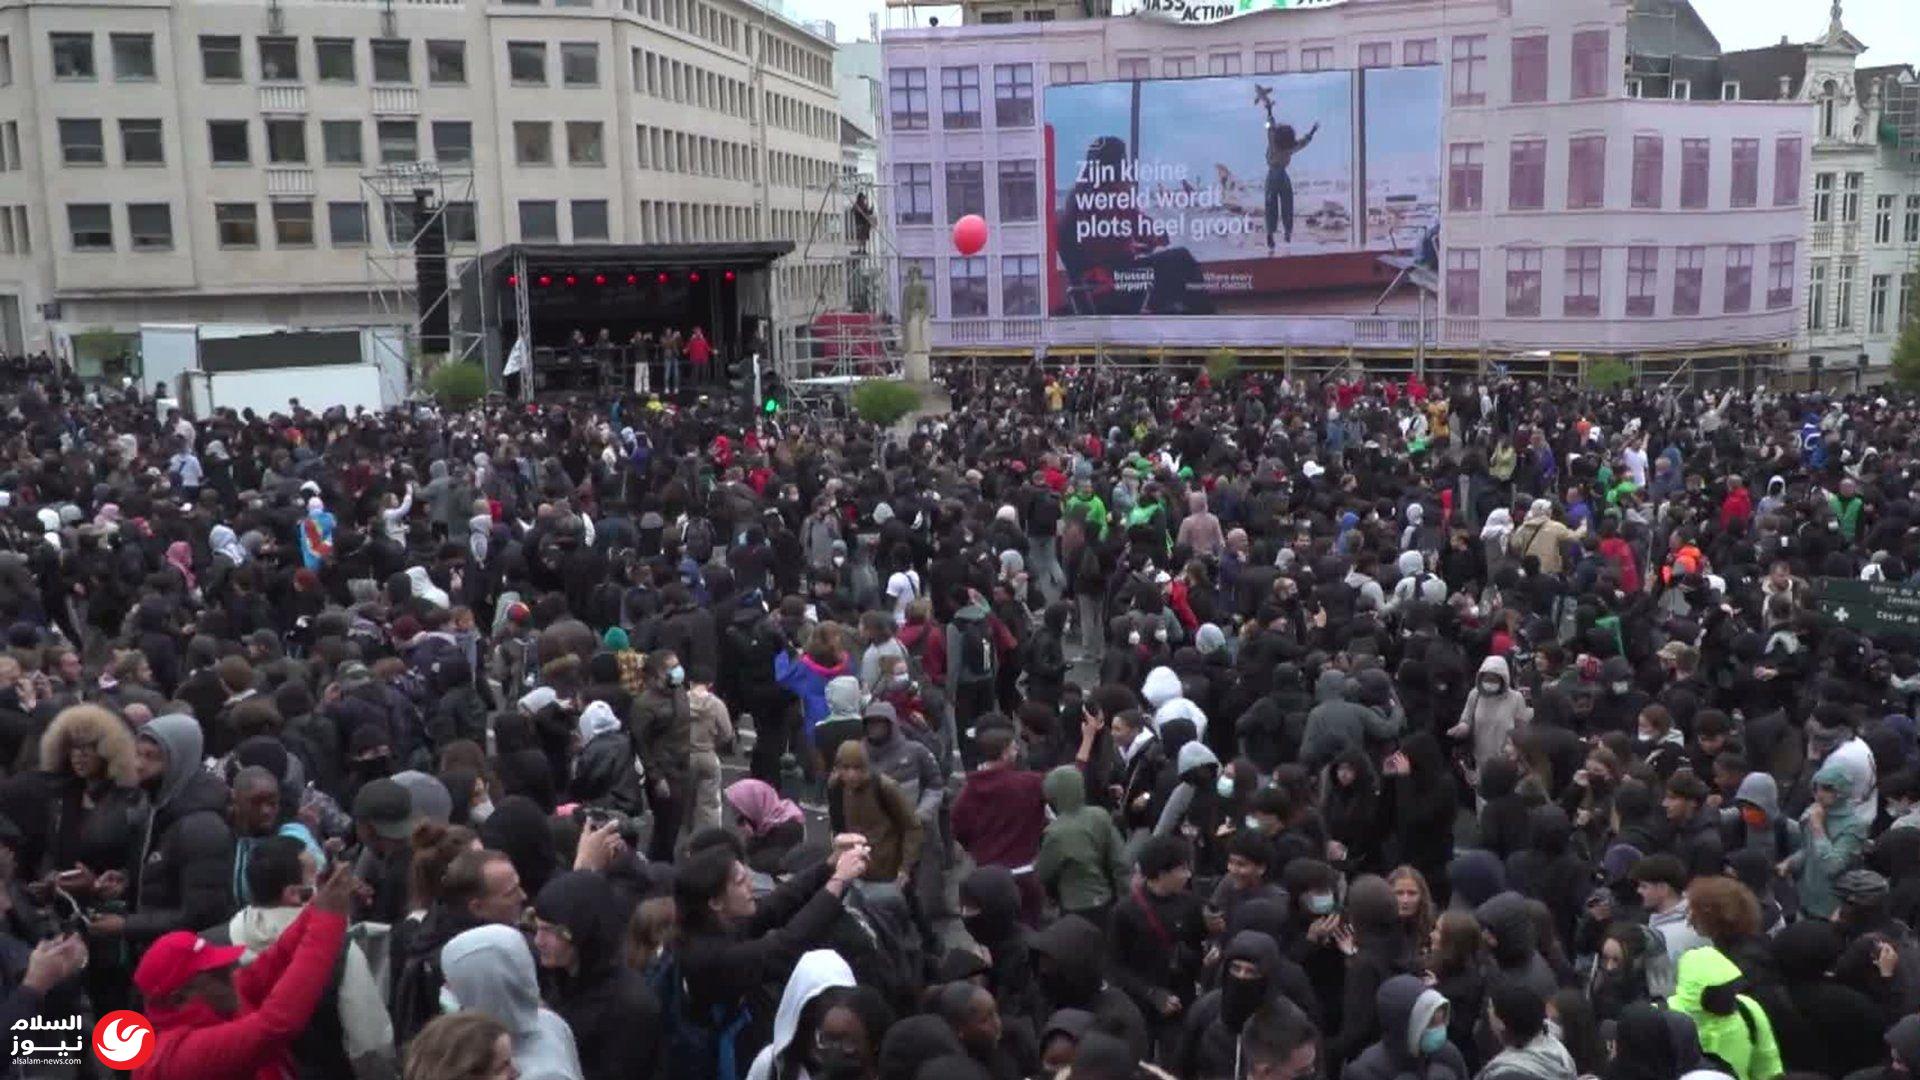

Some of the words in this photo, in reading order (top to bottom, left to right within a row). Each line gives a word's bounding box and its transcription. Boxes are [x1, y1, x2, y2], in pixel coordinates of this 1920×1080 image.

[1181, 6, 1234, 21] ACTION
[1075, 159, 1115, 188] Zijn
[1121, 158, 1187, 182] kleine
[1075, 187, 1150, 210] wereld
[1156, 184, 1222, 208] wordt
[1076, 215, 1132, 243] plots
[1138, 213, 1185, 236] heel
[1191, 212, 1255, 241] groot
[1113, 268, 1155, 281] brussels
[1113, 280, 1149, 292] airport
